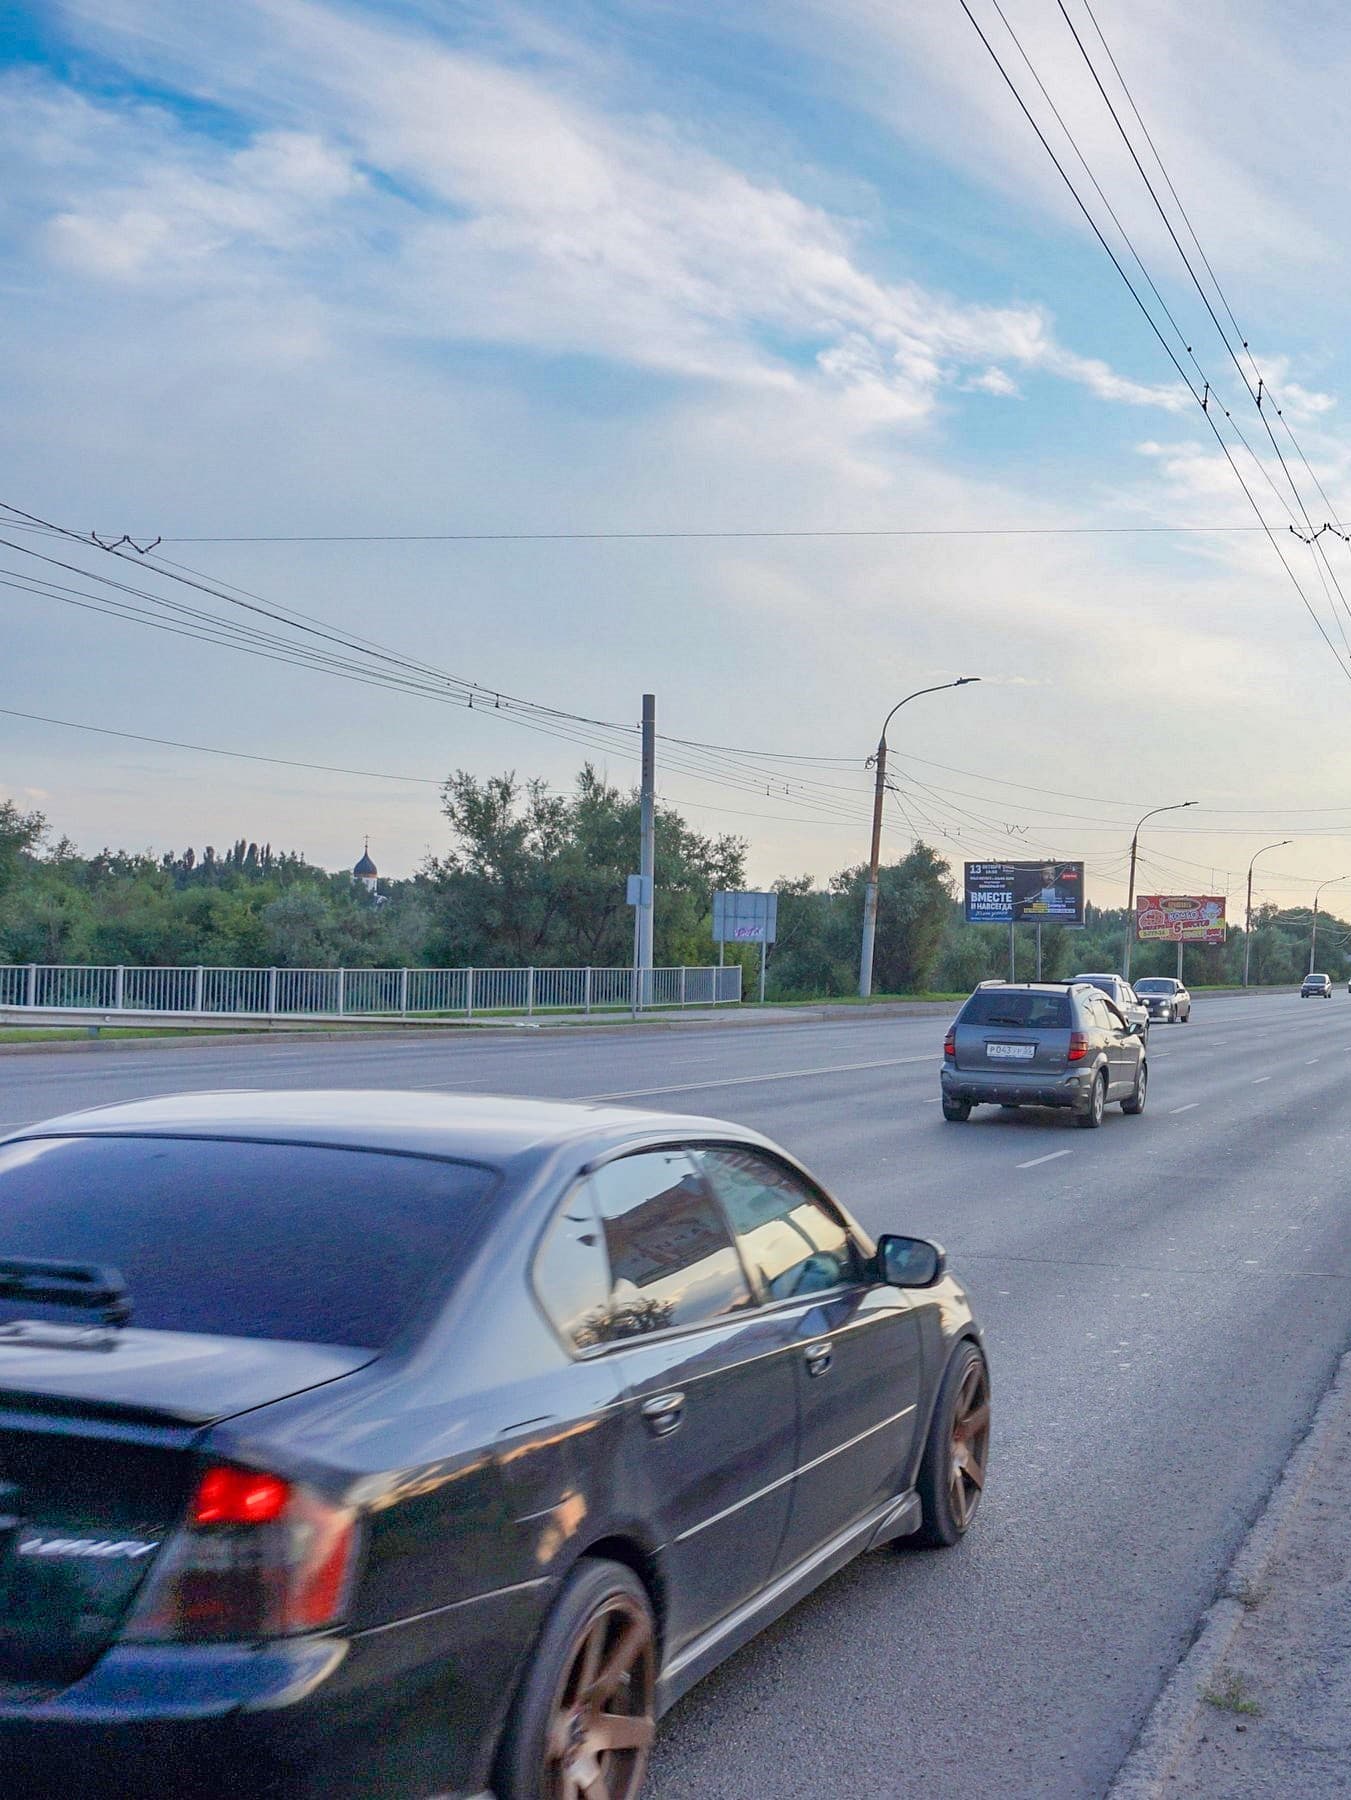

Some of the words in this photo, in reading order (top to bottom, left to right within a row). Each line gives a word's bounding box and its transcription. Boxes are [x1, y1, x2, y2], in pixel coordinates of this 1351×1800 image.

[969, 864, 982, 874] 13
[970, 892, 1013, 902] ВМЕСТЕ
[977, 902, 1013, 911] НАВСЕГДА
